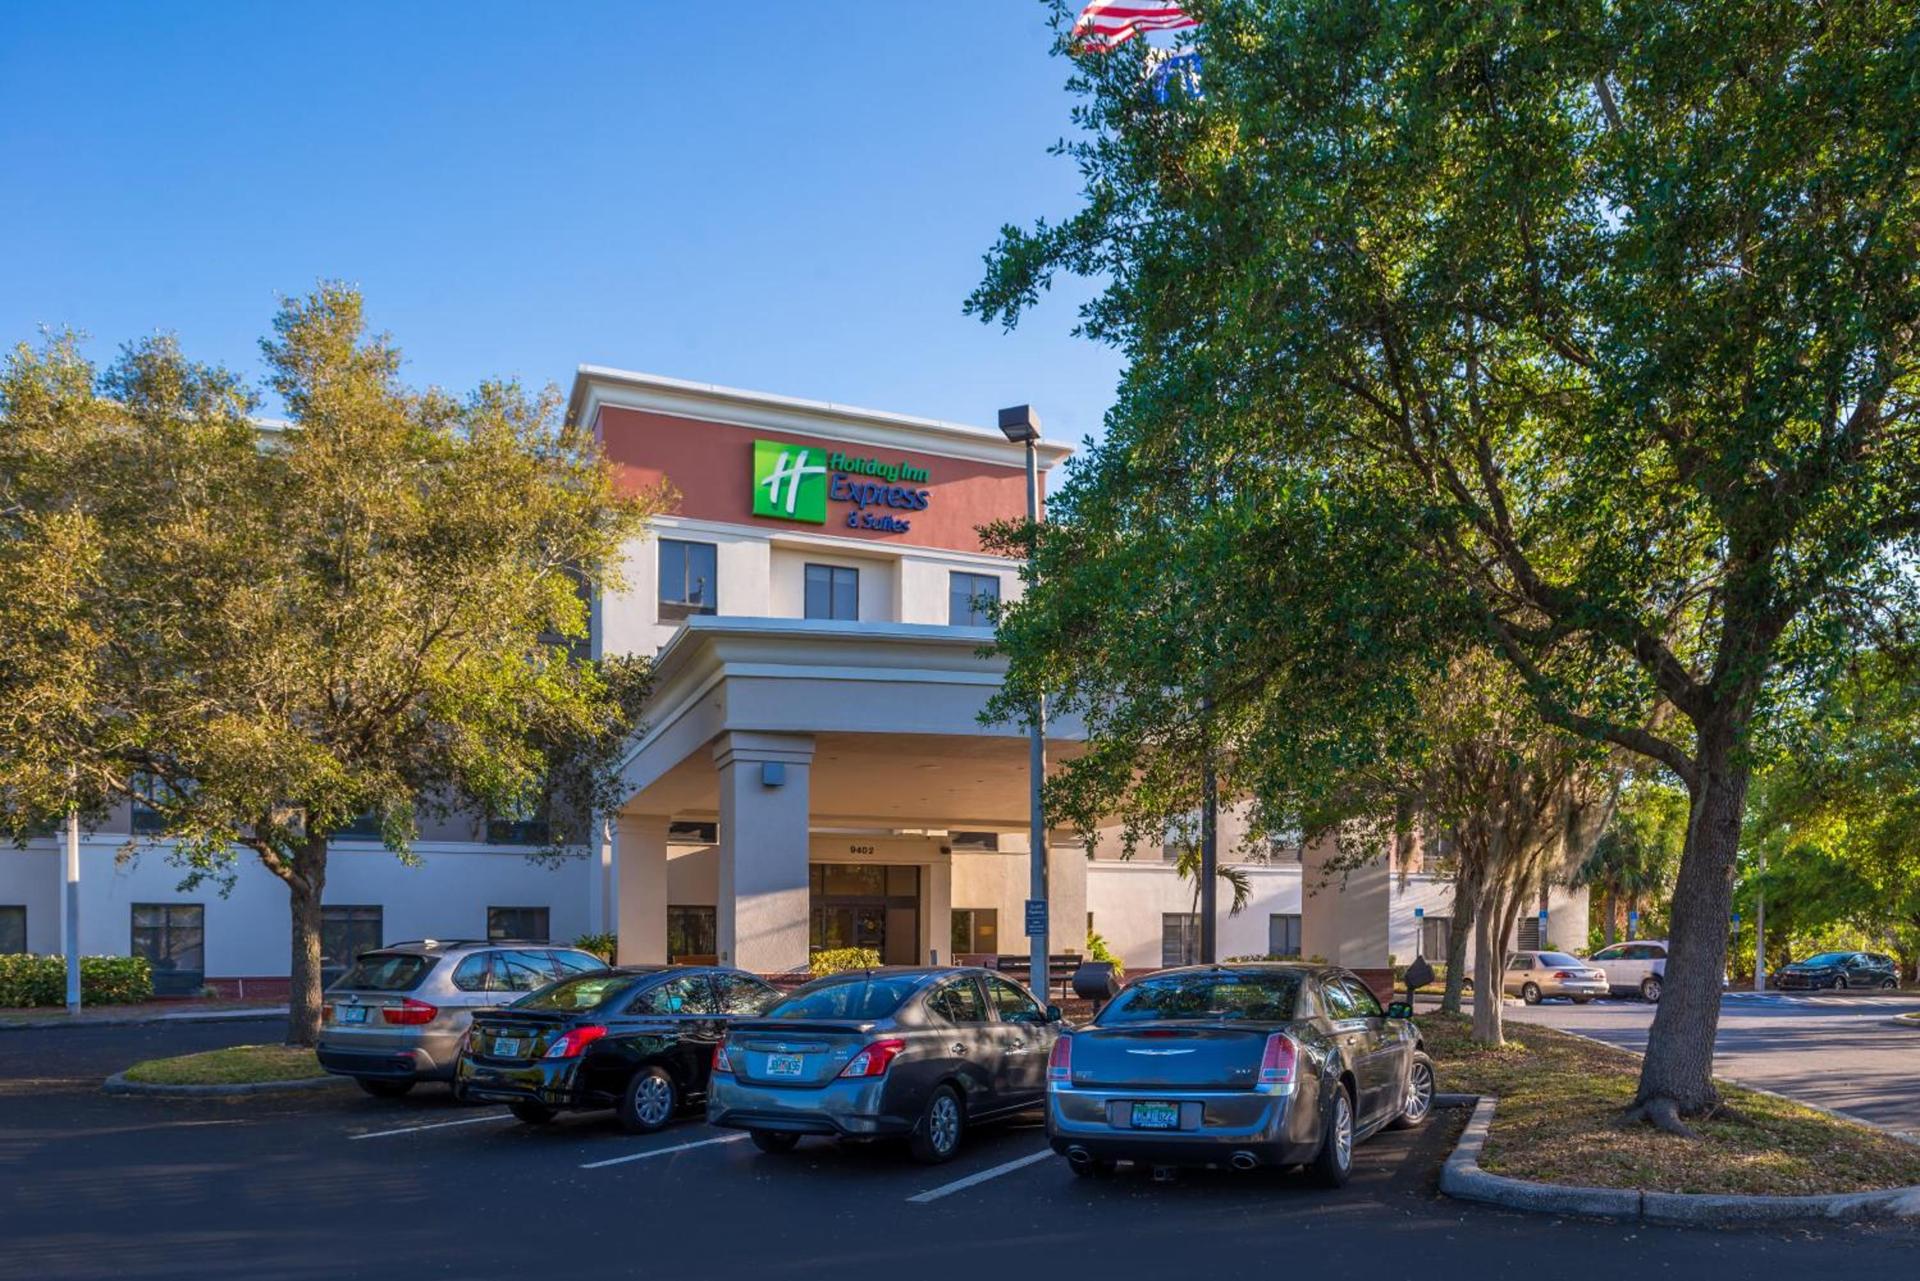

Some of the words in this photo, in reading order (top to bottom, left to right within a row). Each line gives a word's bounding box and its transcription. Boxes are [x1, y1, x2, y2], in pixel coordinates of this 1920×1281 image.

[830, 452, 899, 482] Holiday
[902, 461, 929, 482] Inn
[830, 473, 930, 510] Express
[862, 513, 910, 533] Suites
